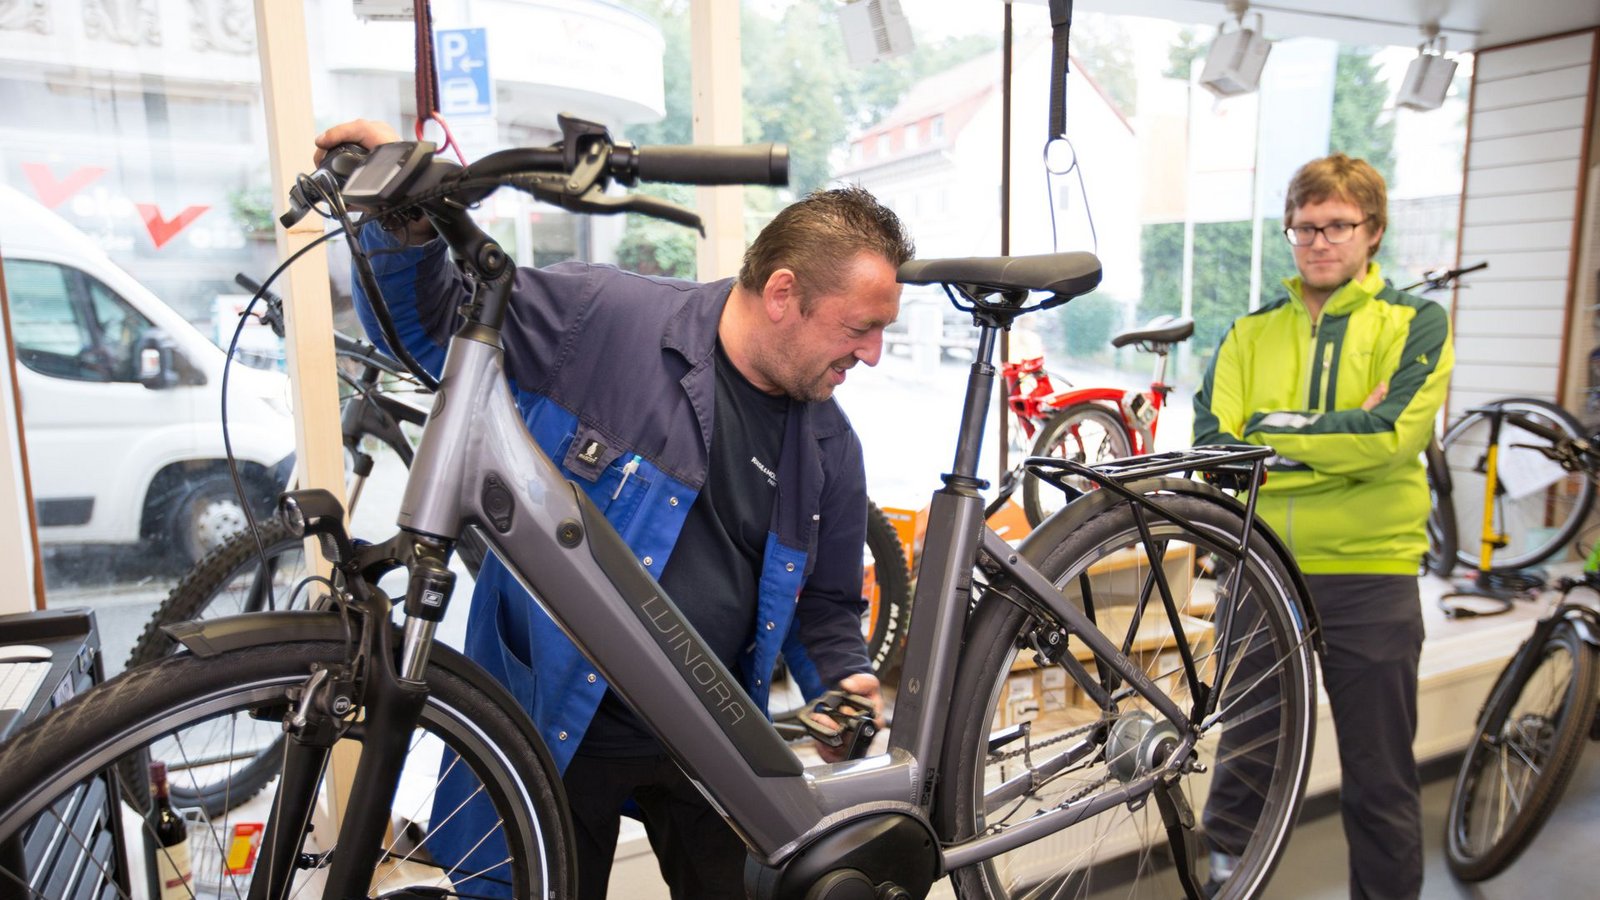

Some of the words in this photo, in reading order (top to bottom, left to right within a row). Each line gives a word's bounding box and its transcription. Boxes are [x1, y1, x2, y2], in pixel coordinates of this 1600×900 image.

[442, 33, 468, 71] P
[641, 595, 746, 726] WINORA
[1113, 652, 1150, 689] SINUS
